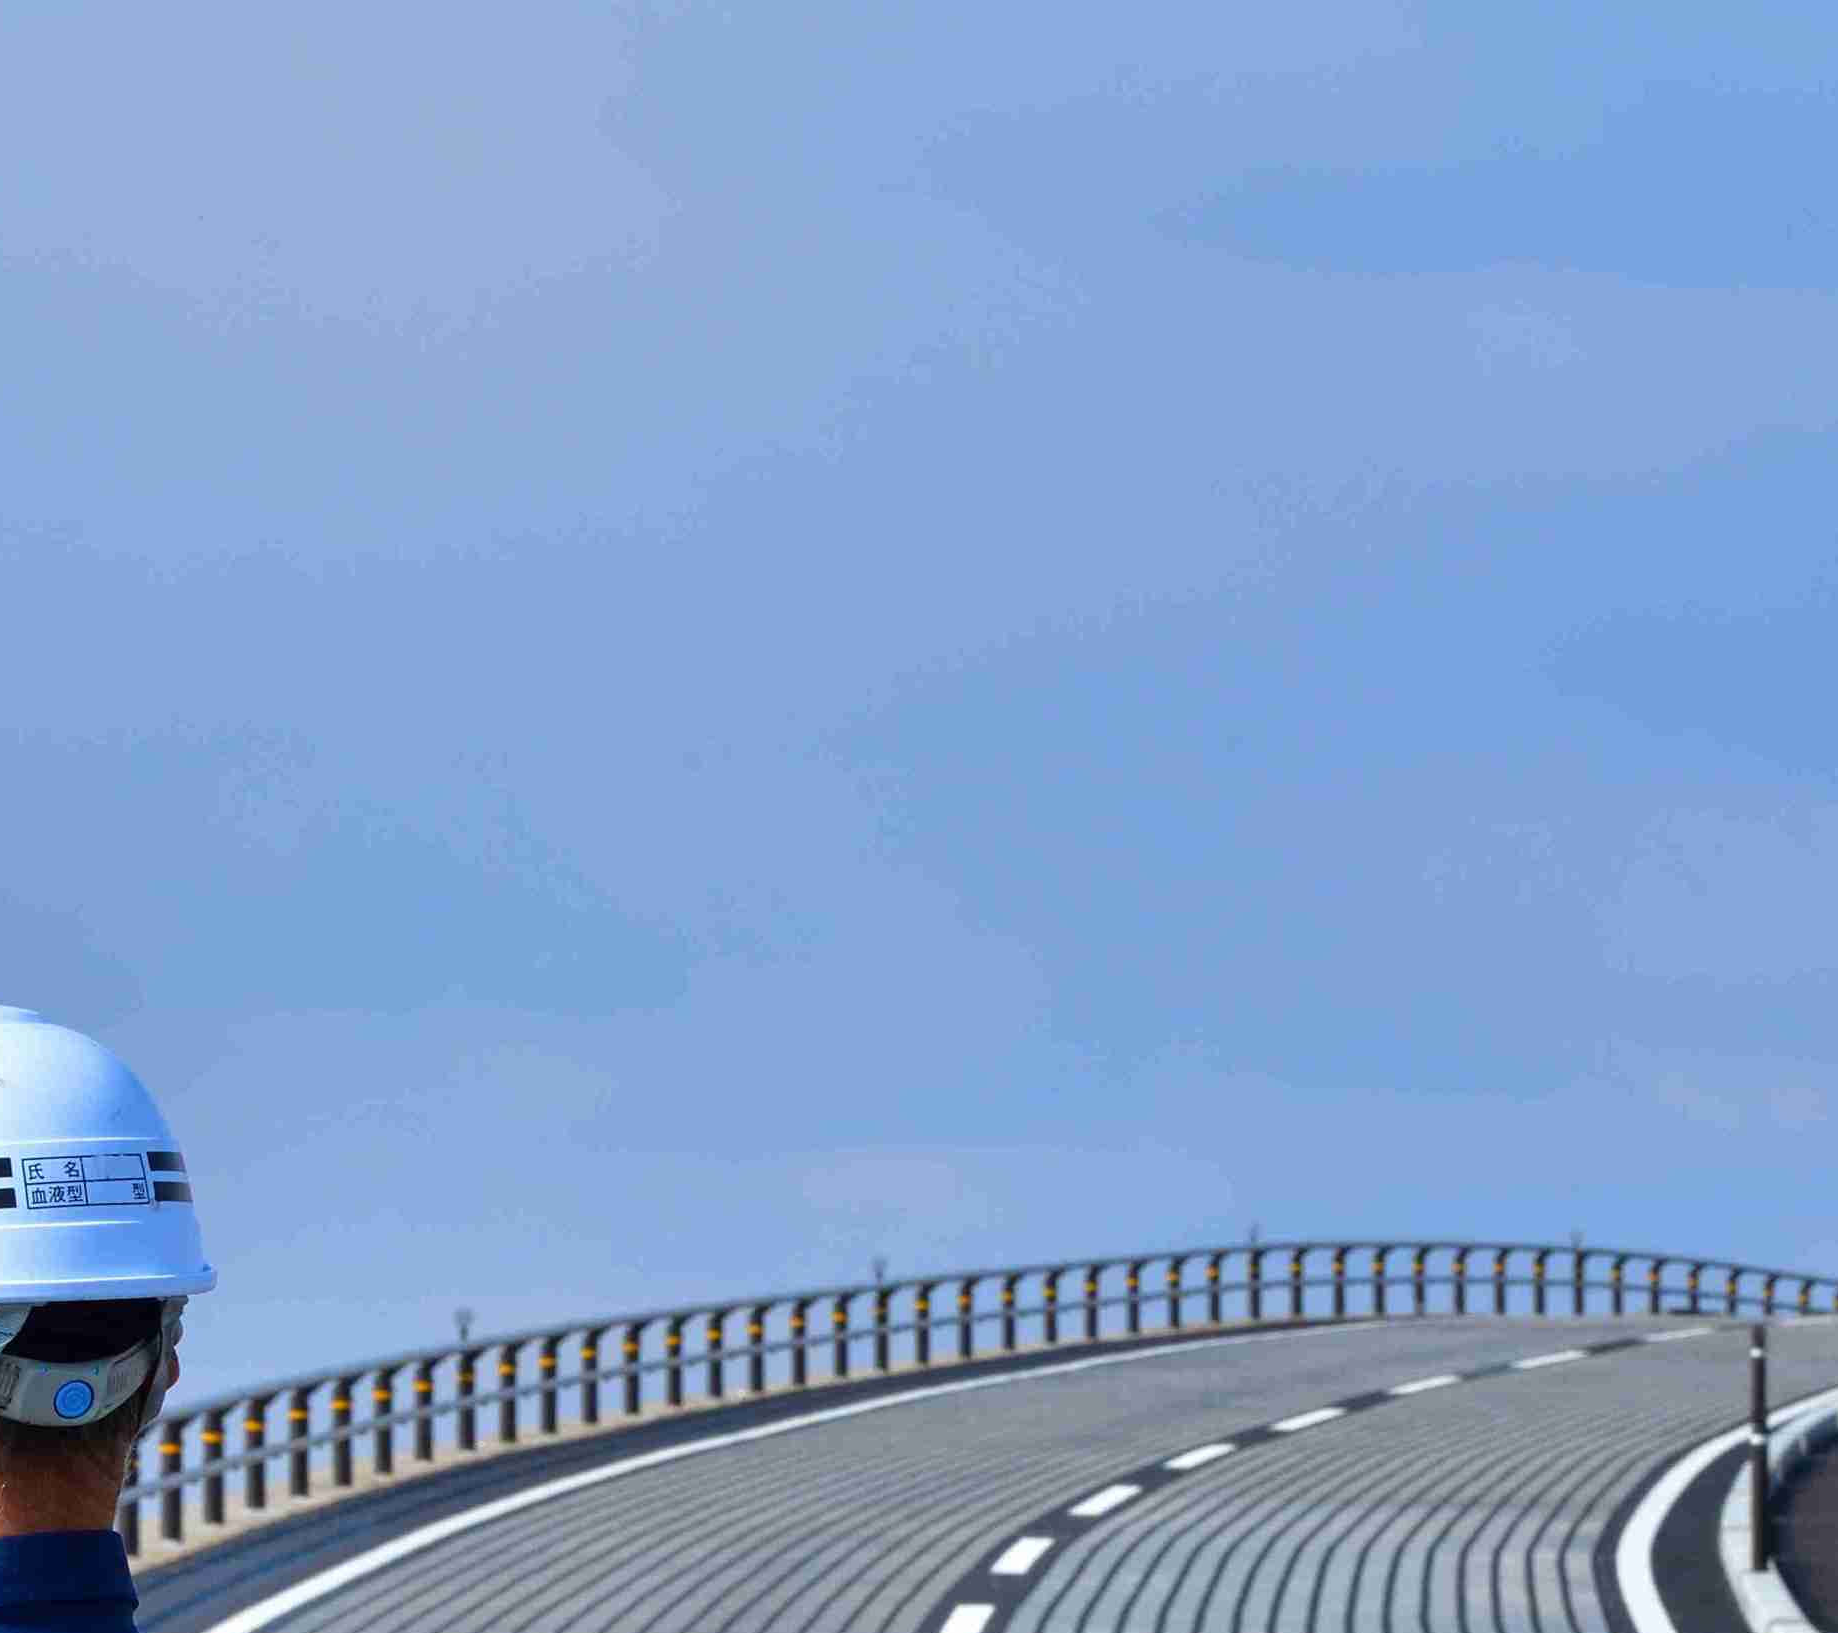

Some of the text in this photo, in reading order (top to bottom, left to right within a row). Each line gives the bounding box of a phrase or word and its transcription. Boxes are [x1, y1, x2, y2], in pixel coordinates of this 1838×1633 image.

[31, 1183, 84, 1205] 血液型
[132, 1183, 146, 1200] 型
